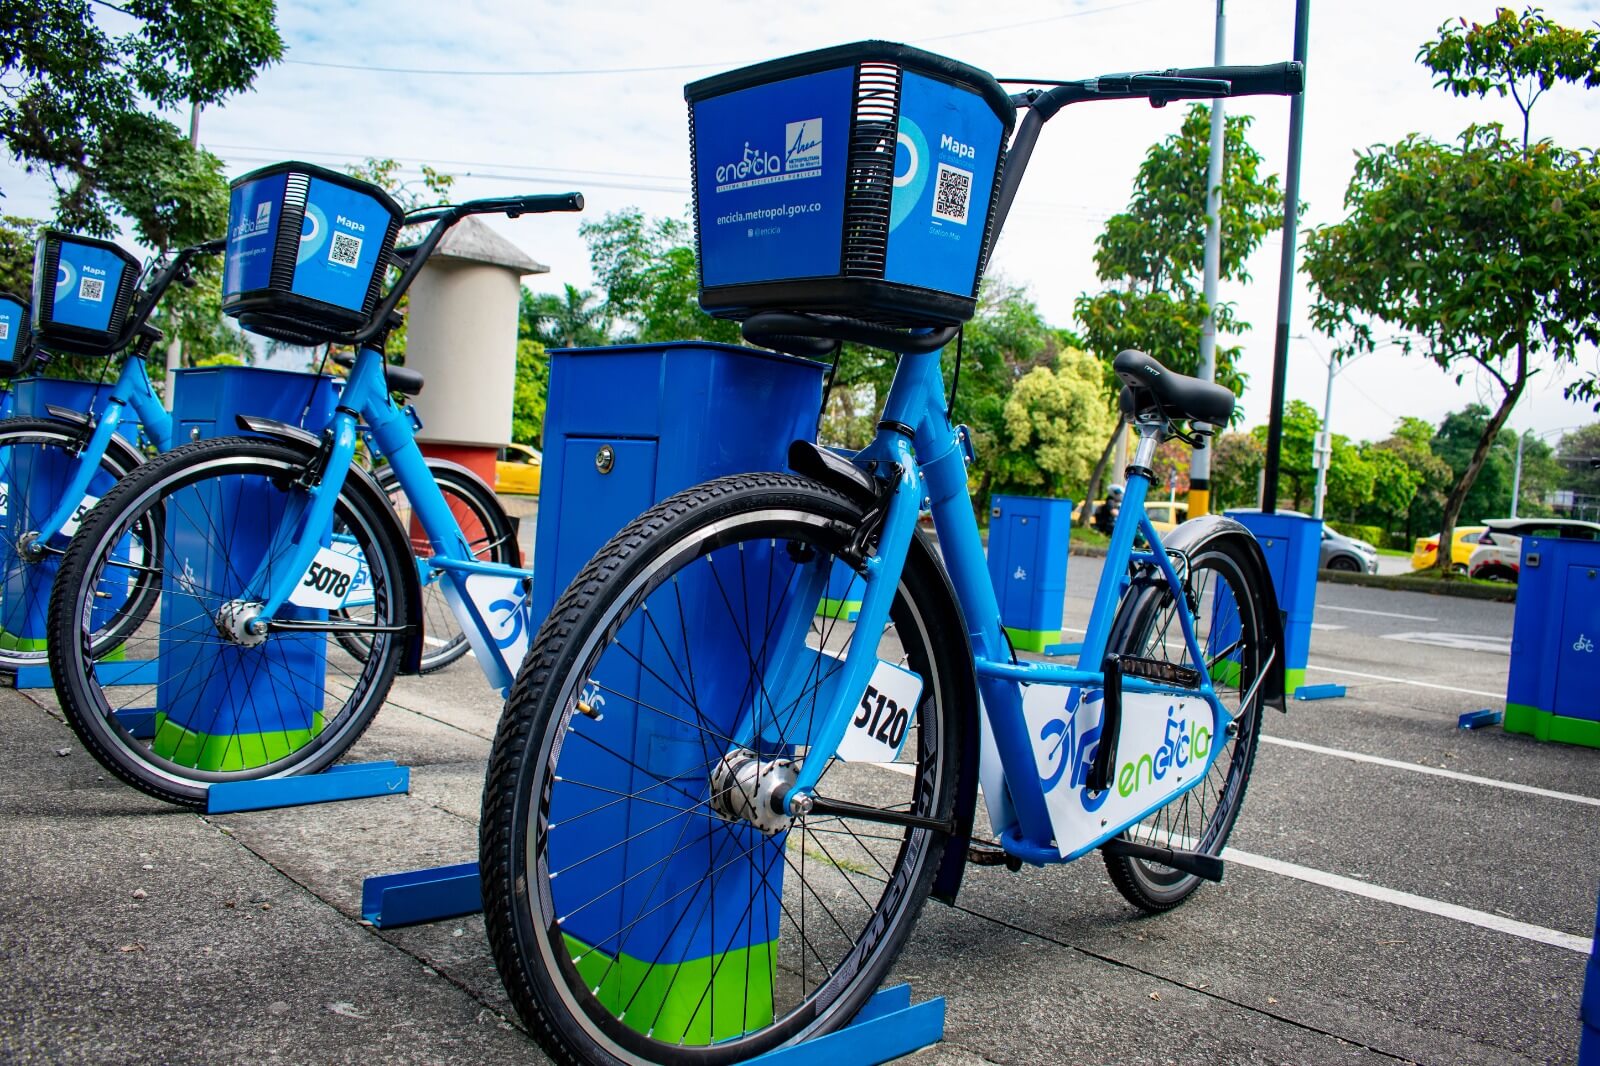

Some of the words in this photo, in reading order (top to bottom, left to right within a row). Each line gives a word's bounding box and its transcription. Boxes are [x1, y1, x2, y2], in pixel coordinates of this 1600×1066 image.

[940, 133, 975, 159] Mapa
[336, 214, 366, 232] Mapa
[717, 202, 821, 225] encicla.metropol.gov.co
[82, 265, 106, 276] Mapa
[303, 561, 351, 598] 5078
[853, 684, 909, 750] 5120
[1117, 704, 1209, 798] encicla
